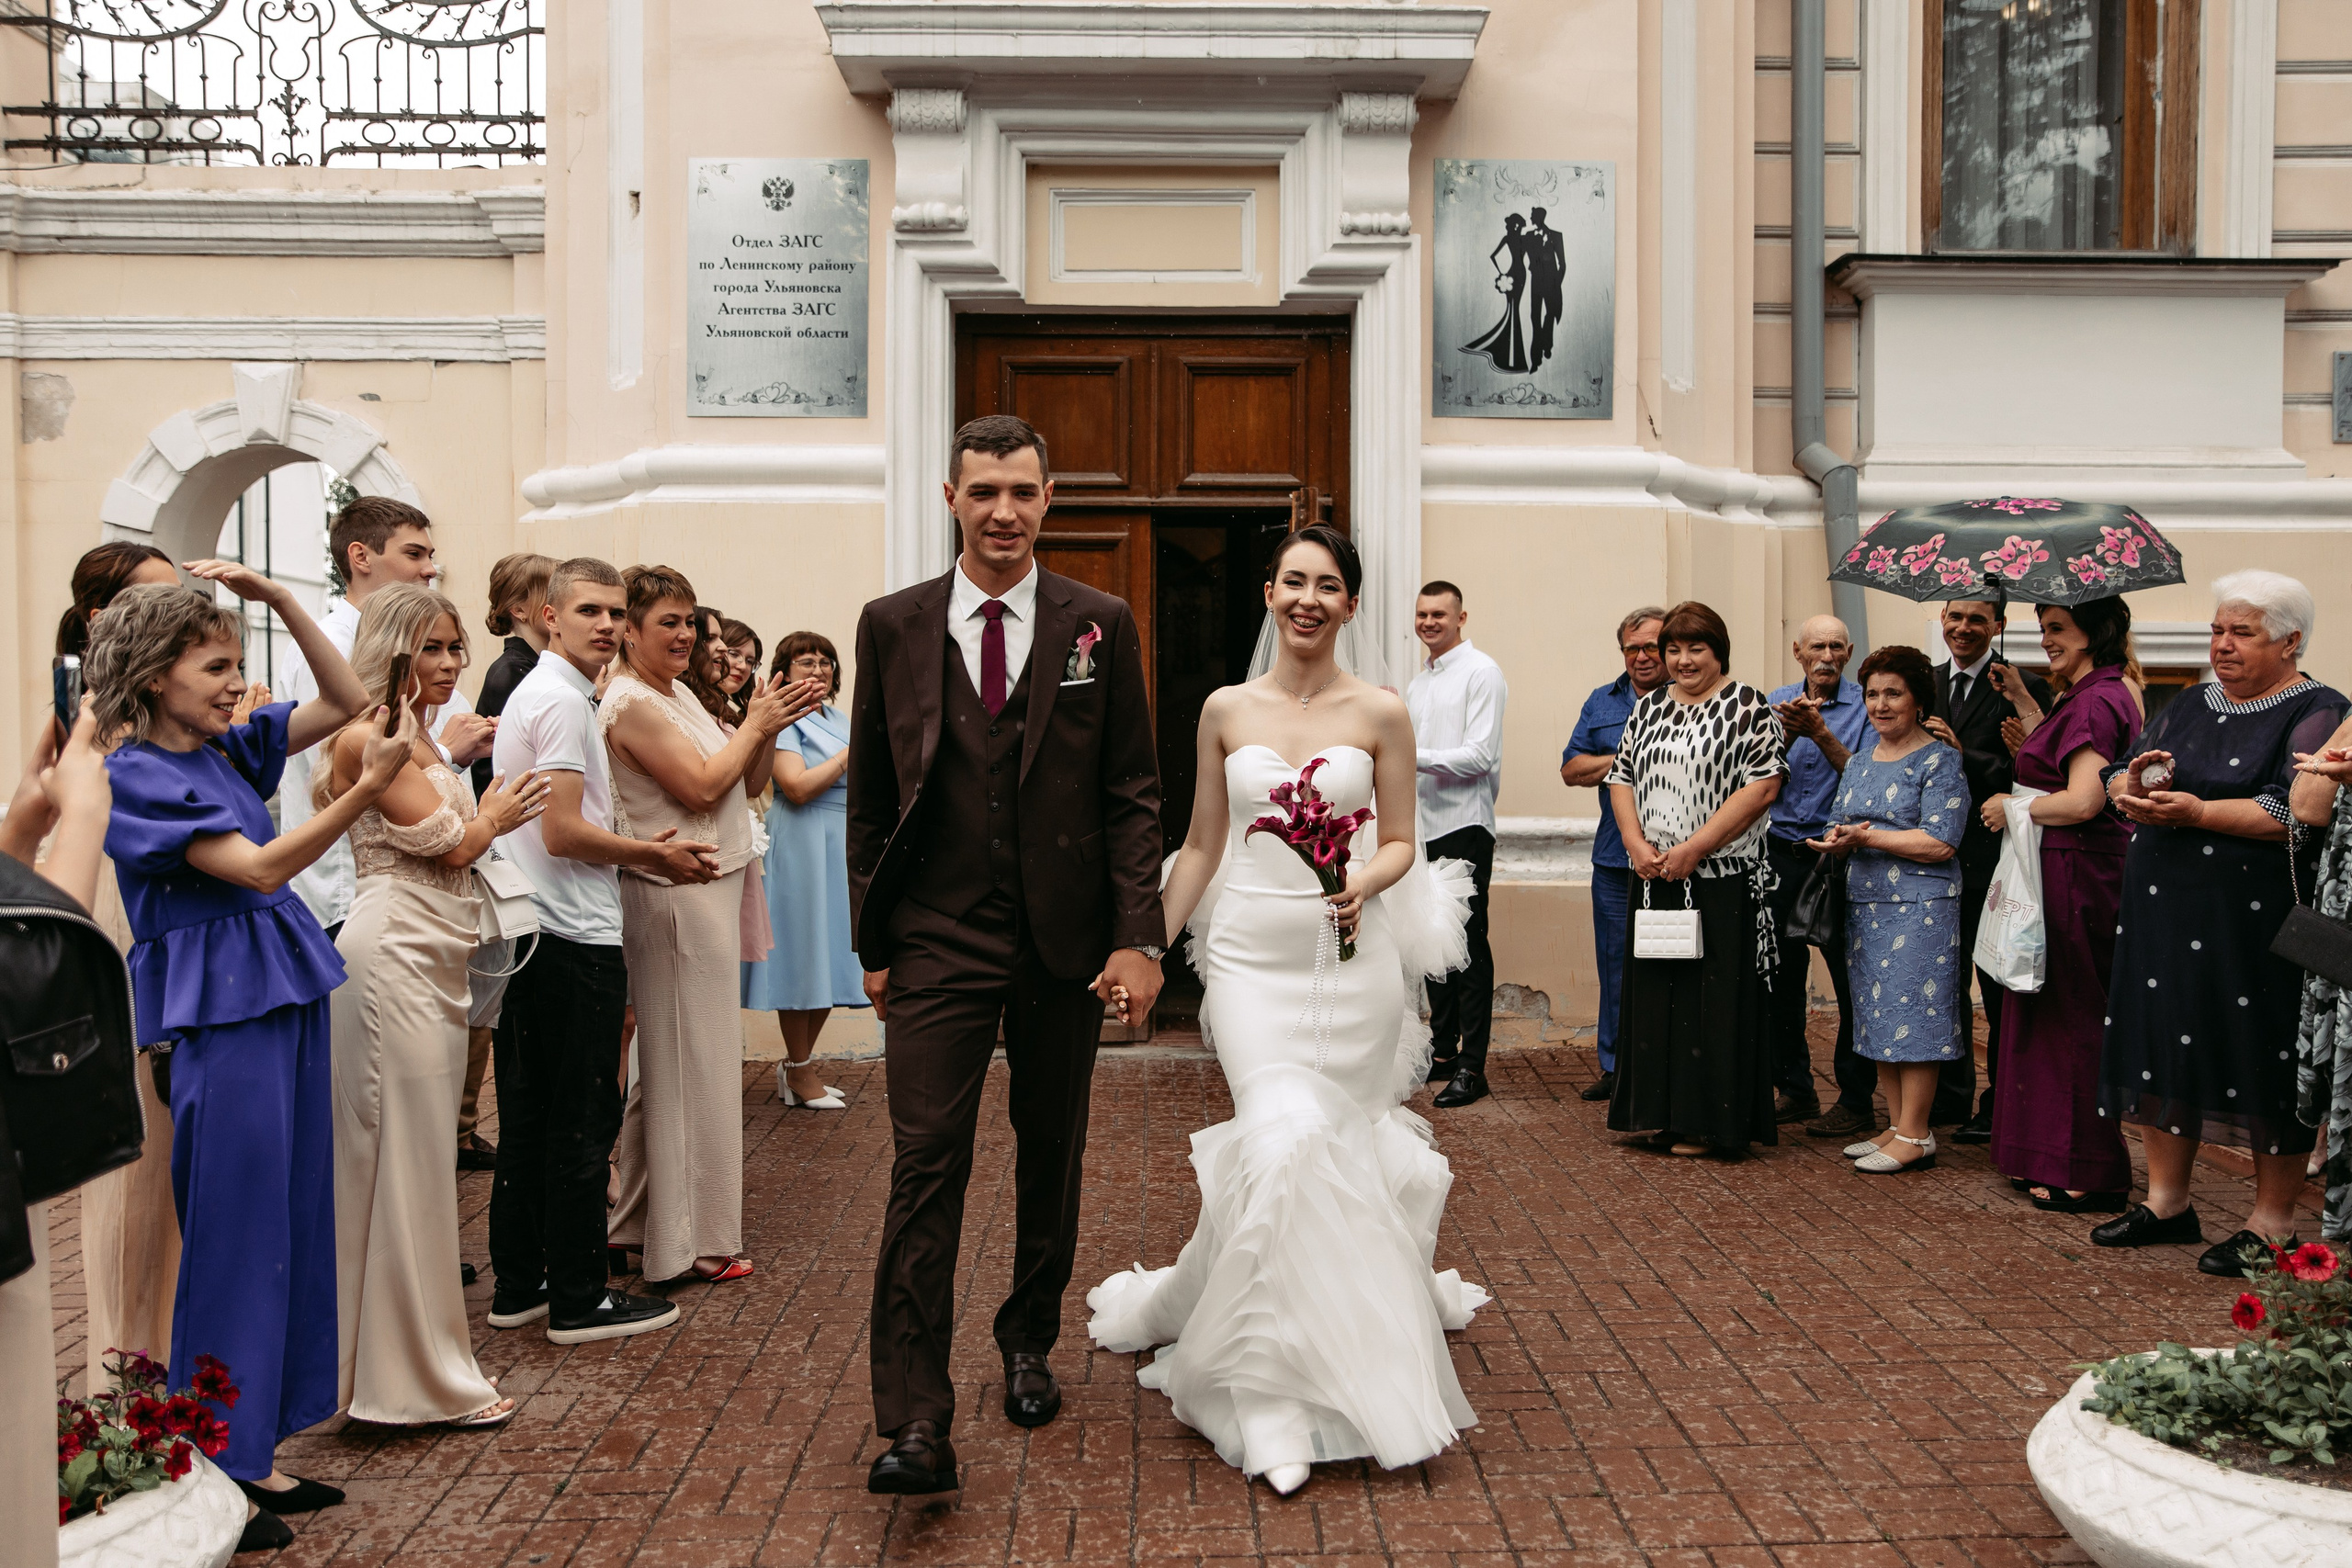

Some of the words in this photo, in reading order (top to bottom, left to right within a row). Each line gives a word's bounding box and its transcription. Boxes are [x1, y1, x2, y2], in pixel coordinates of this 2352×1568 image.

[731, 234, 774, 250] Отдел
[778, 234, 824, 248] ЗАГС
[698, 262, 716, 271] по
[719, 257, 804, 274] Ленинскому
[808, 259, 857, 274] району
[713, 284, 759, 296] города
[763, 279, 842, 294] Ульяновска
[717, 302, 787, 316] Агентства
[791, 302, 837, 316] ЗАГС
[706, 324, 792, 338] Ульяновской
[797, 327, 850, 339] области
